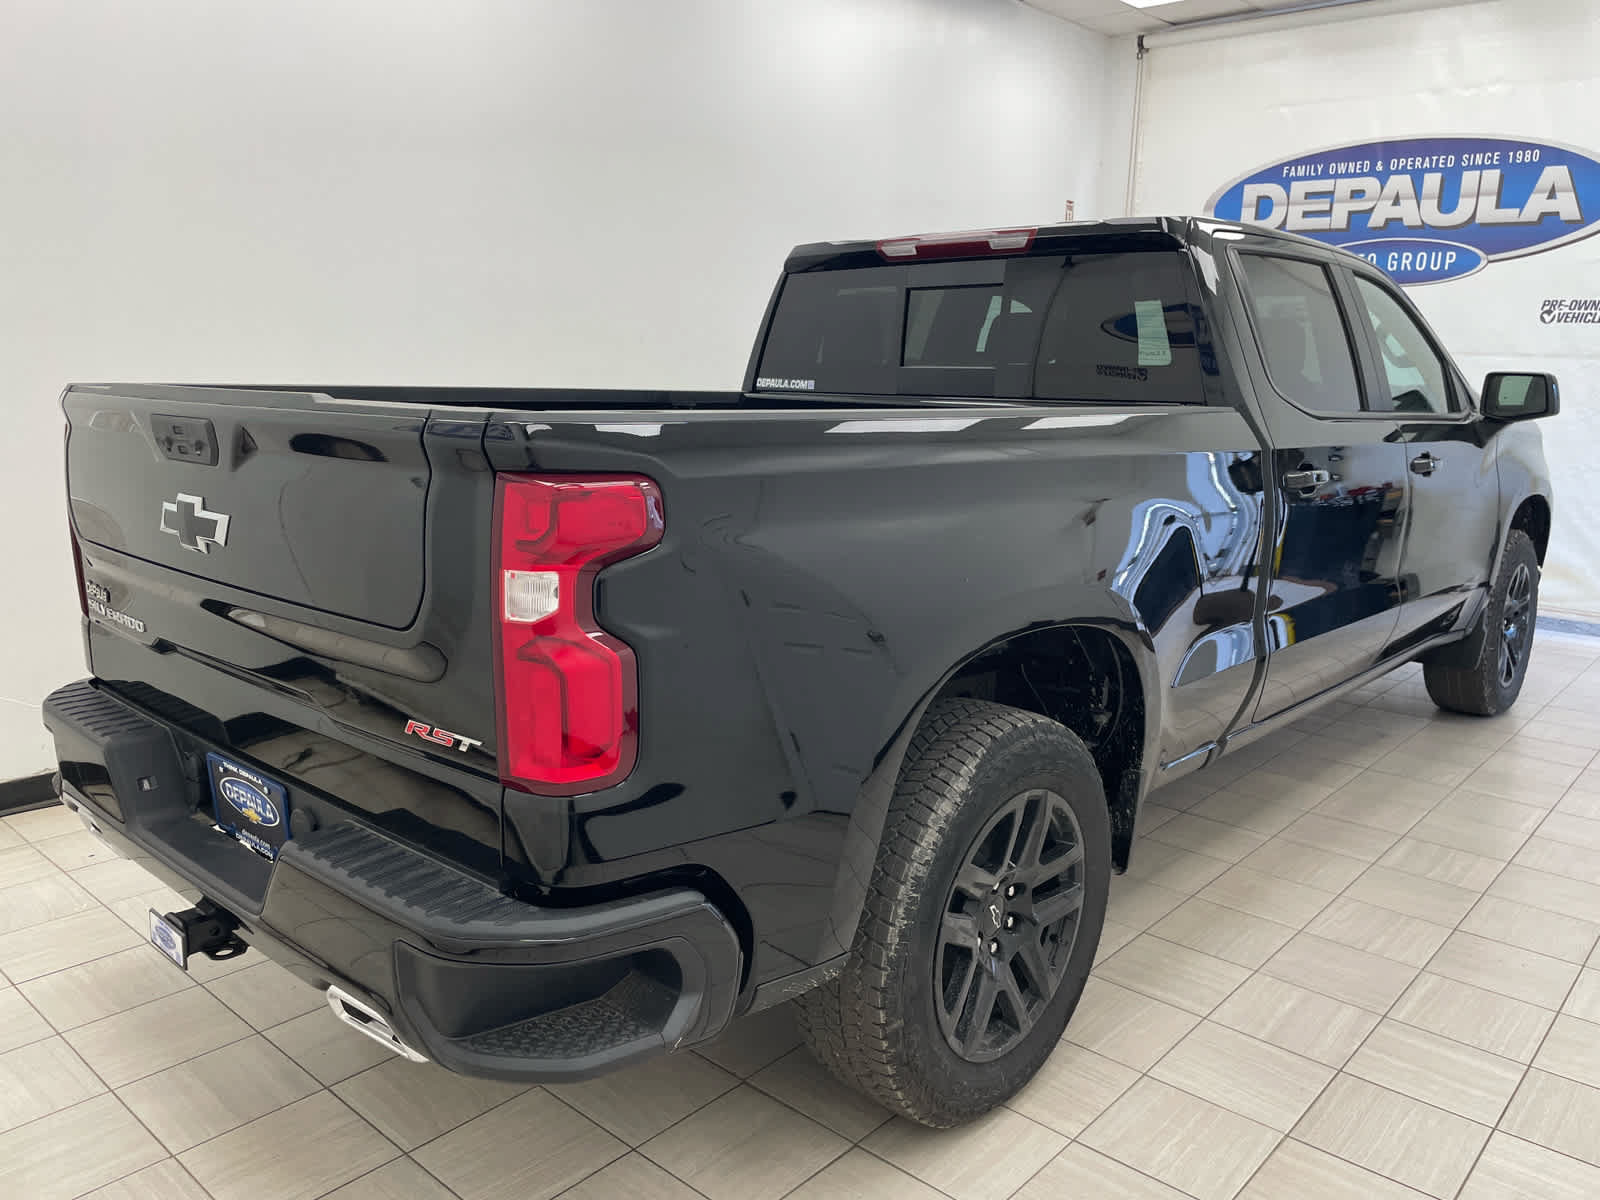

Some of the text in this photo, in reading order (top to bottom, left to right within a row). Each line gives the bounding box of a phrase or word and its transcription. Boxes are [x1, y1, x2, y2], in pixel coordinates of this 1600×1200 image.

[1282, 149, 1540, 178] FAMILY OWNED & OPERATED SINCE 1980
[1240, 165, 1583, 231] DEPAULA
[1387, 251, 1457, 271] GROUP
[1540, 299, 1600, 311] PRE-OWN
[1557, 311, 1600, 324] VEHICL
[756, 377, 808, 390] DEPAULA.COM
[404, 719, 483, 752] RST
[224, 781, 275, 821] DEPAULA
